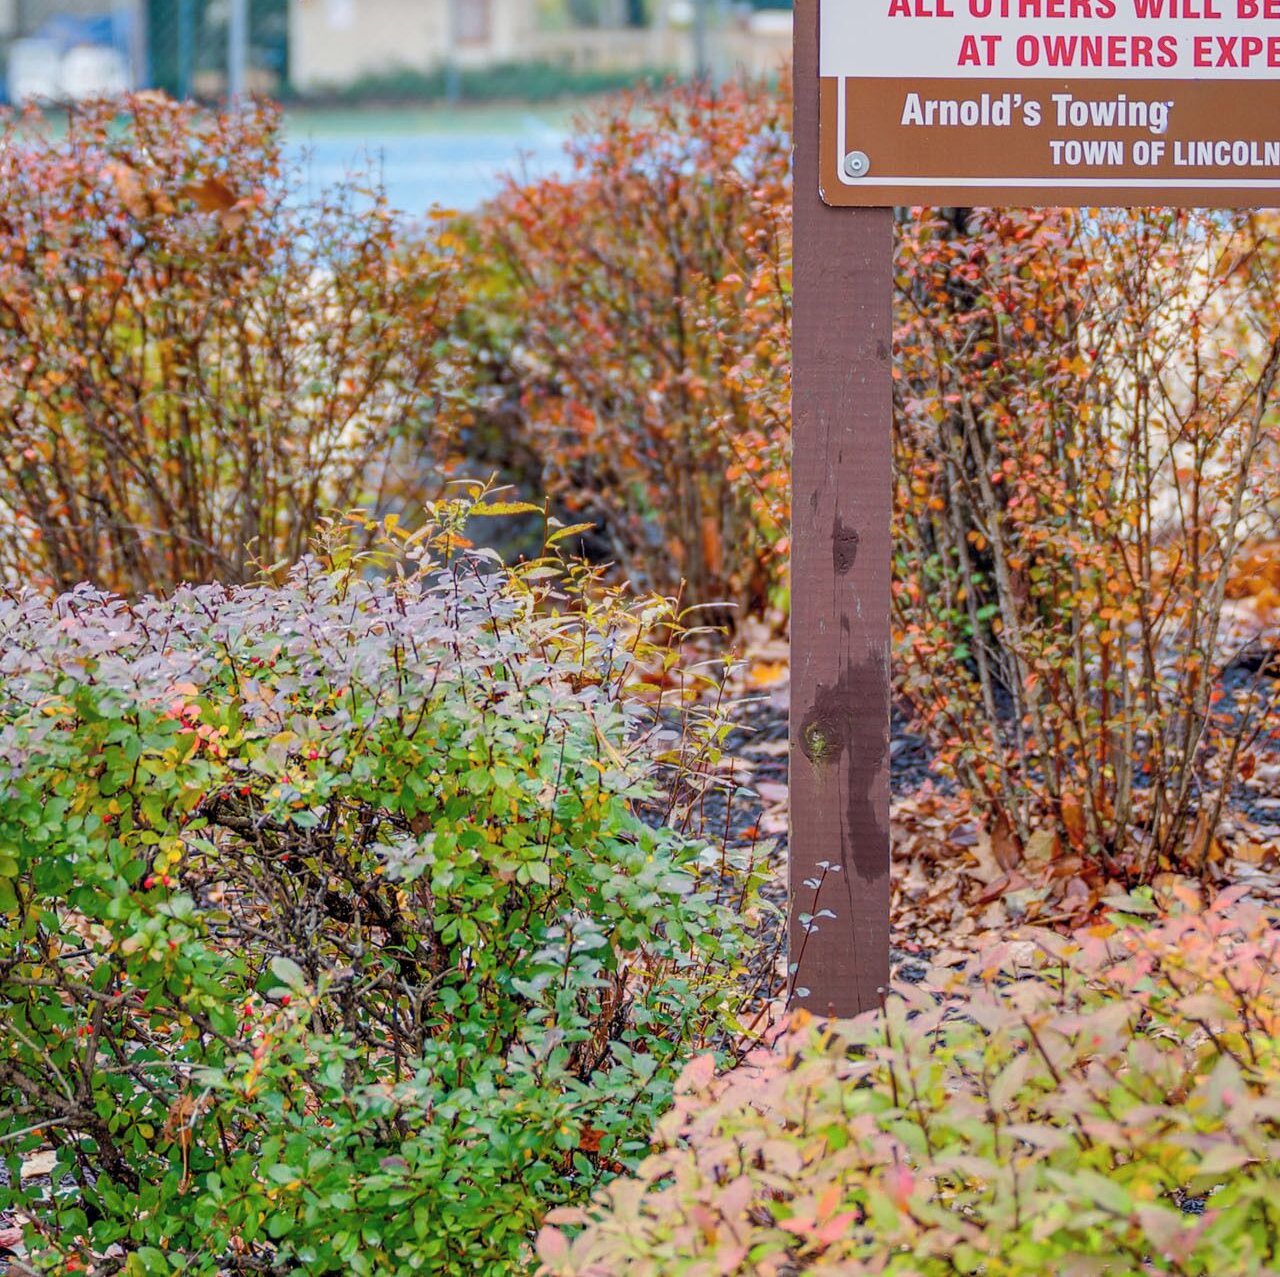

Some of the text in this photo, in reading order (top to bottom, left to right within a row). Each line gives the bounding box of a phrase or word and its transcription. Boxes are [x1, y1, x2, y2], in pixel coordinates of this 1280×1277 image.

[957, 34, 1003, 67] AT
[1015, 34, 1178, 68] OWNERS
[1051, 94, 1169, 134] Towing
[1049, 140, 1280, 166] TOWN OF LINCOLN
